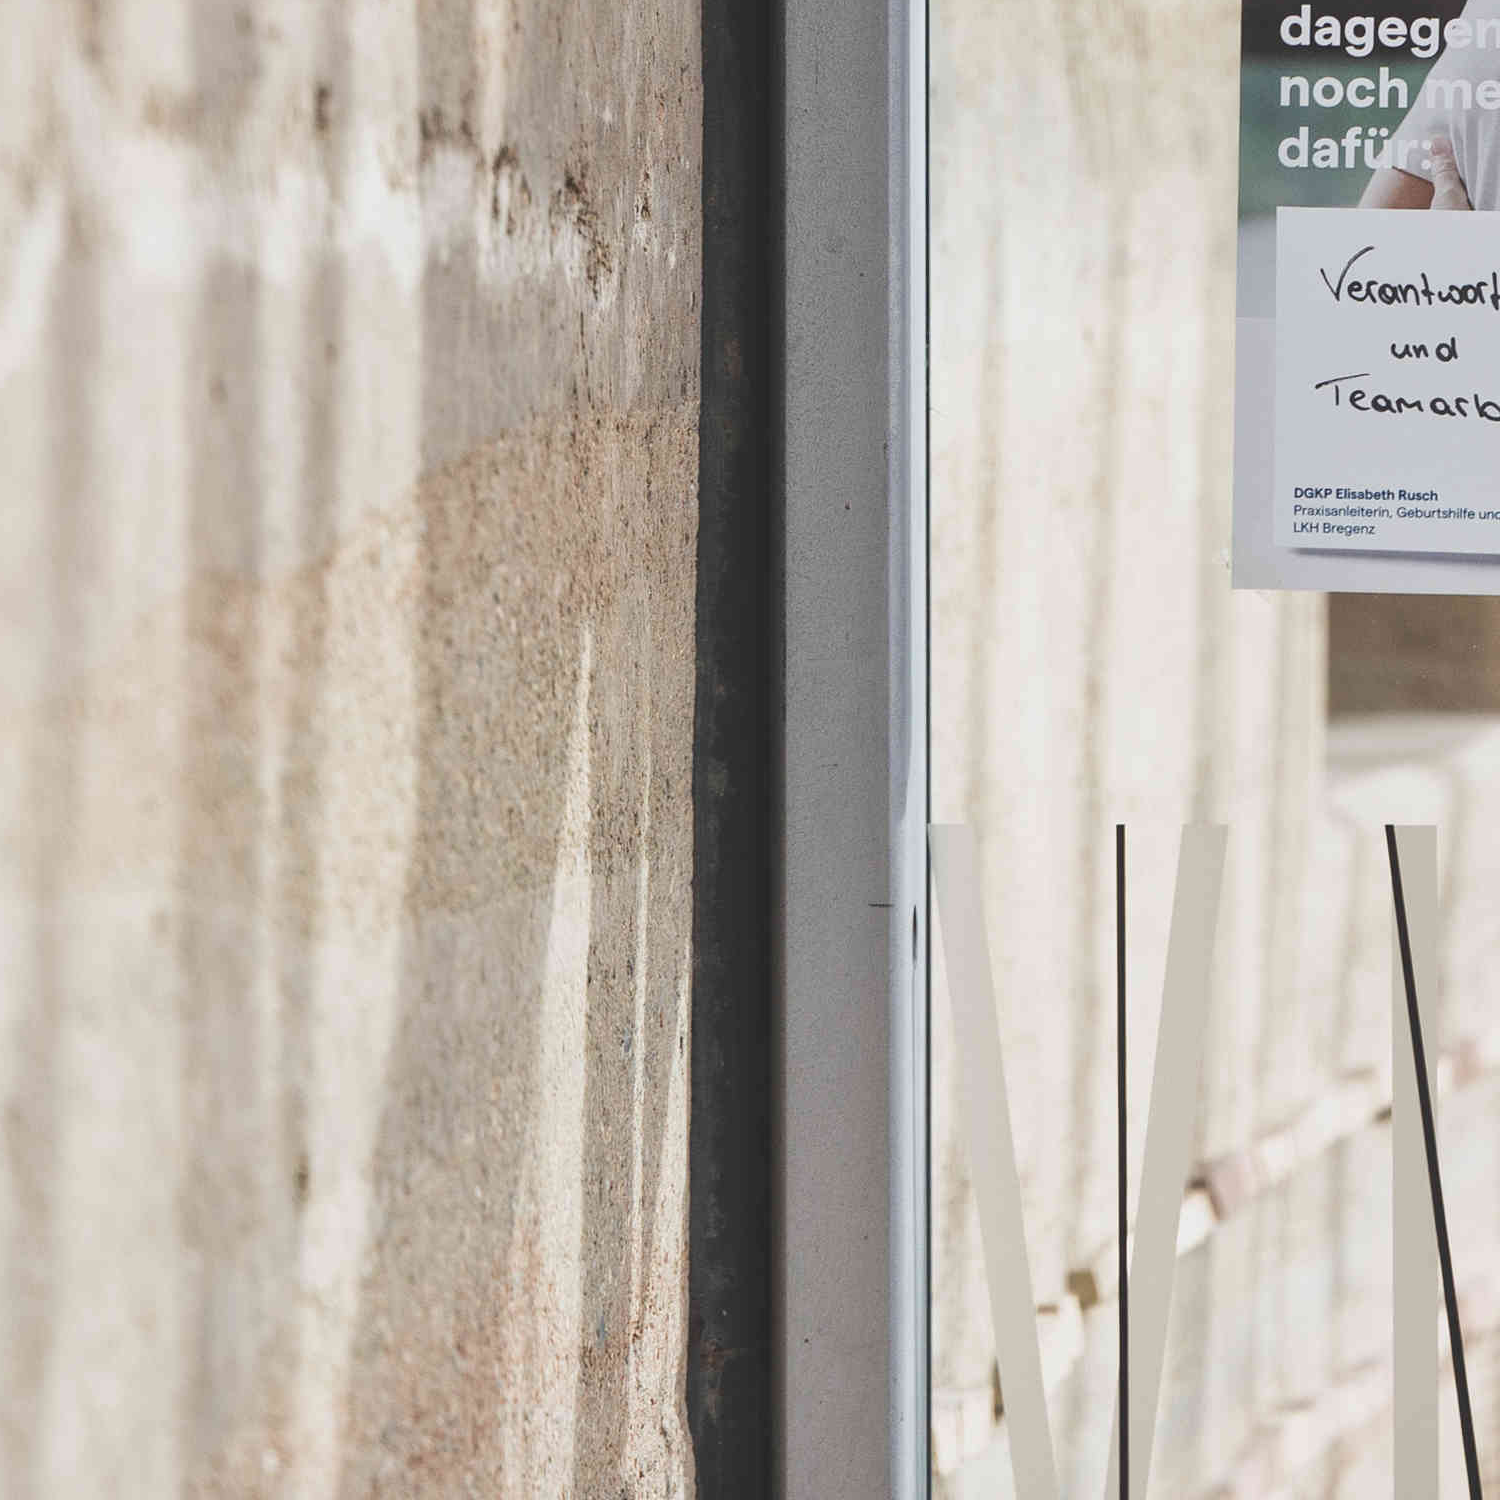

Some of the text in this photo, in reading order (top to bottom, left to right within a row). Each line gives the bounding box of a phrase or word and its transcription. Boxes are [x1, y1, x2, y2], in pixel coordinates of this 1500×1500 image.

[1279, 66, 1408, 109] noch
[1277, 126, 1433, 170] dafür:
[1390, 337, 1458, 362] und
[1294, 487, 1438, 501] DGKP Elisabeth Rusch
[1293, 504, 1393, 519] Praxisanleiterin,
[1397, 507, 1476, 520] Geburtshilfe
[1293, 522, 1376, 536] LKH Bregenz
